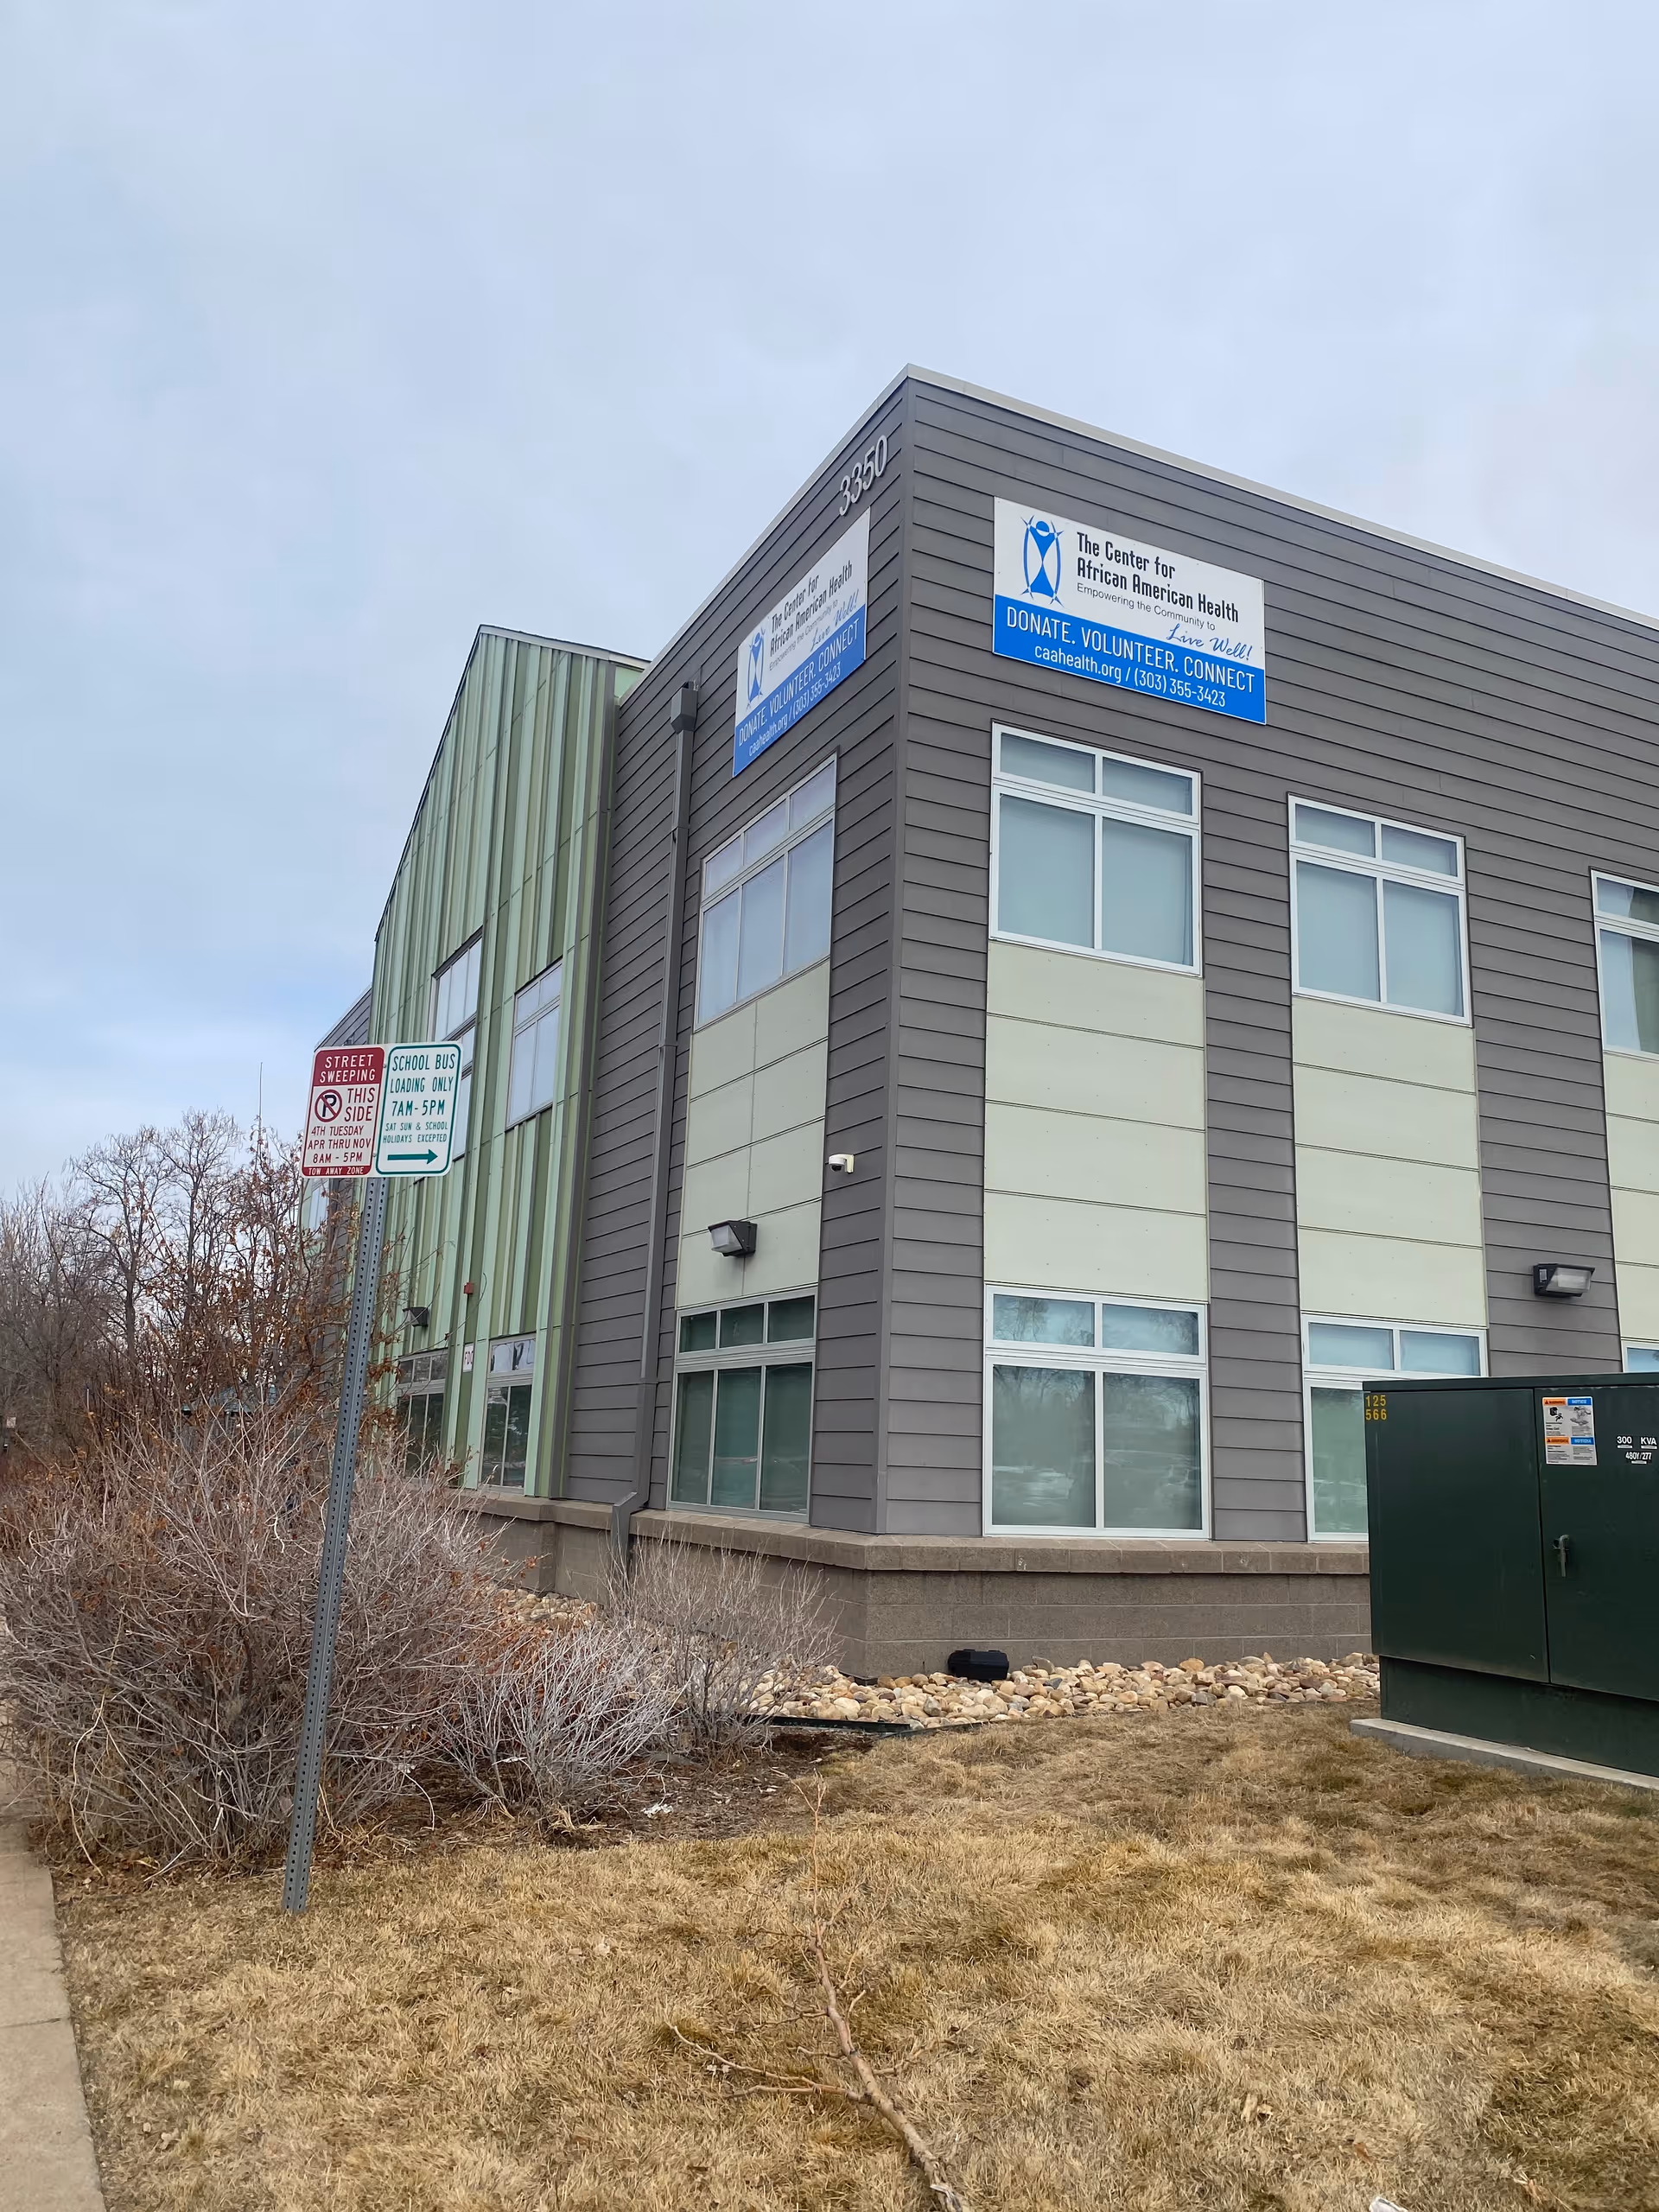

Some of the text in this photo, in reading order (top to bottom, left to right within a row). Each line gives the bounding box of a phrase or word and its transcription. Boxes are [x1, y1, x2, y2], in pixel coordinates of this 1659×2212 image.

[839, 435, 887, 516] 3350
[1077, 531, 1175, 579] The Center for
[1077, 556, 1238, 623] African American Health
[770, 559, 852, 657] African American Health
[772, 575, 819, 633] The Center for
[1077, 582, 1216, 631] Empowering the Community to
[769, 641, 796, 671] Empowering
[805, 607, 831, 635] Community
[810, 626, 830, 652] Live
[1166, 623, 1253, 661] Live Well!
[1007, 606, 1255, 693] DONATE. VOLUNTEER. CONNECT
[739, 618, 859, 747] DONATE. VOLUNTEER. CONNECT
[1034, 645, 1225, 707] caahealth.org / (303) 355-3423
[748, 714, 788, 757] caahealth.org
[792, 690, 810, 720] (303)
[810, 661, 841, 702] 355-3423
[325, 1054, 373, 1069] STREET
[392, 1053, 455, 1071] SCHOOL BUS
[320, 1069, 375, 1084] SWEEPING
[390, 1077, 454, 1093] LOADING ONLY
[347, 1087, 375, 1103] THIS
[344, 1106, 373, 1122] SIDE
[311, 1125, 364, 1136] 4TH TUESDAY
[385, 1122, 397, 1131] SAT
[400, 1122, 412, 1130] SUN
[425, 1122, 448, 1130] SCHOOL
[308, 1138, 372, 1150] APR THRU NOV
[383, 1134, 447, 1143] HOLIDAYS EXCEPTED
[313, 1153, 332, 1163] 8AM
[343, 1152, 363, 1163] 5PM
[325, 1166, 343, 1175] AWAY
[1365, 1395, 1386, 1407] 125
[1365, 1408, 1387, 1421] 566
[1617, 1435, 1657, 1446] 300 KVA
